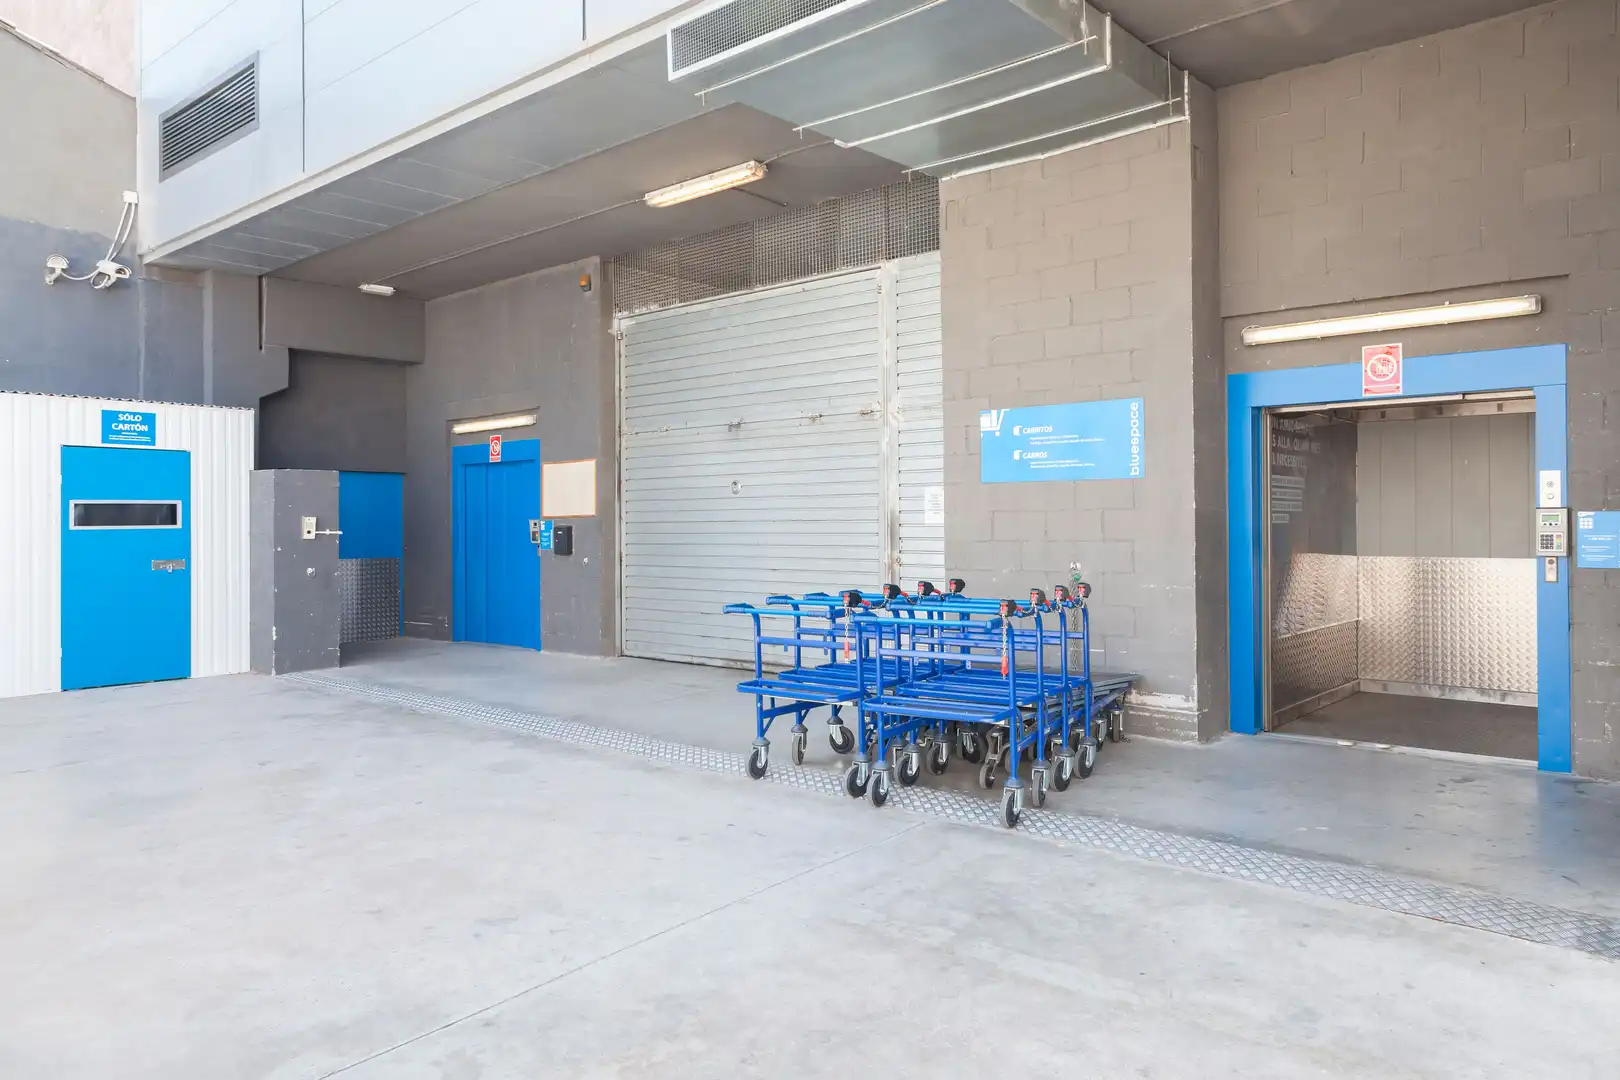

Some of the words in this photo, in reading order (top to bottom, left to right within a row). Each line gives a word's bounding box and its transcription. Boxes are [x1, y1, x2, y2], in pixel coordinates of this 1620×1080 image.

[118, 413, 142, 421] SÓLO
[112, 423, 148, 431] CARTÓN
[1130, 402, 1141, 476] bluespace
